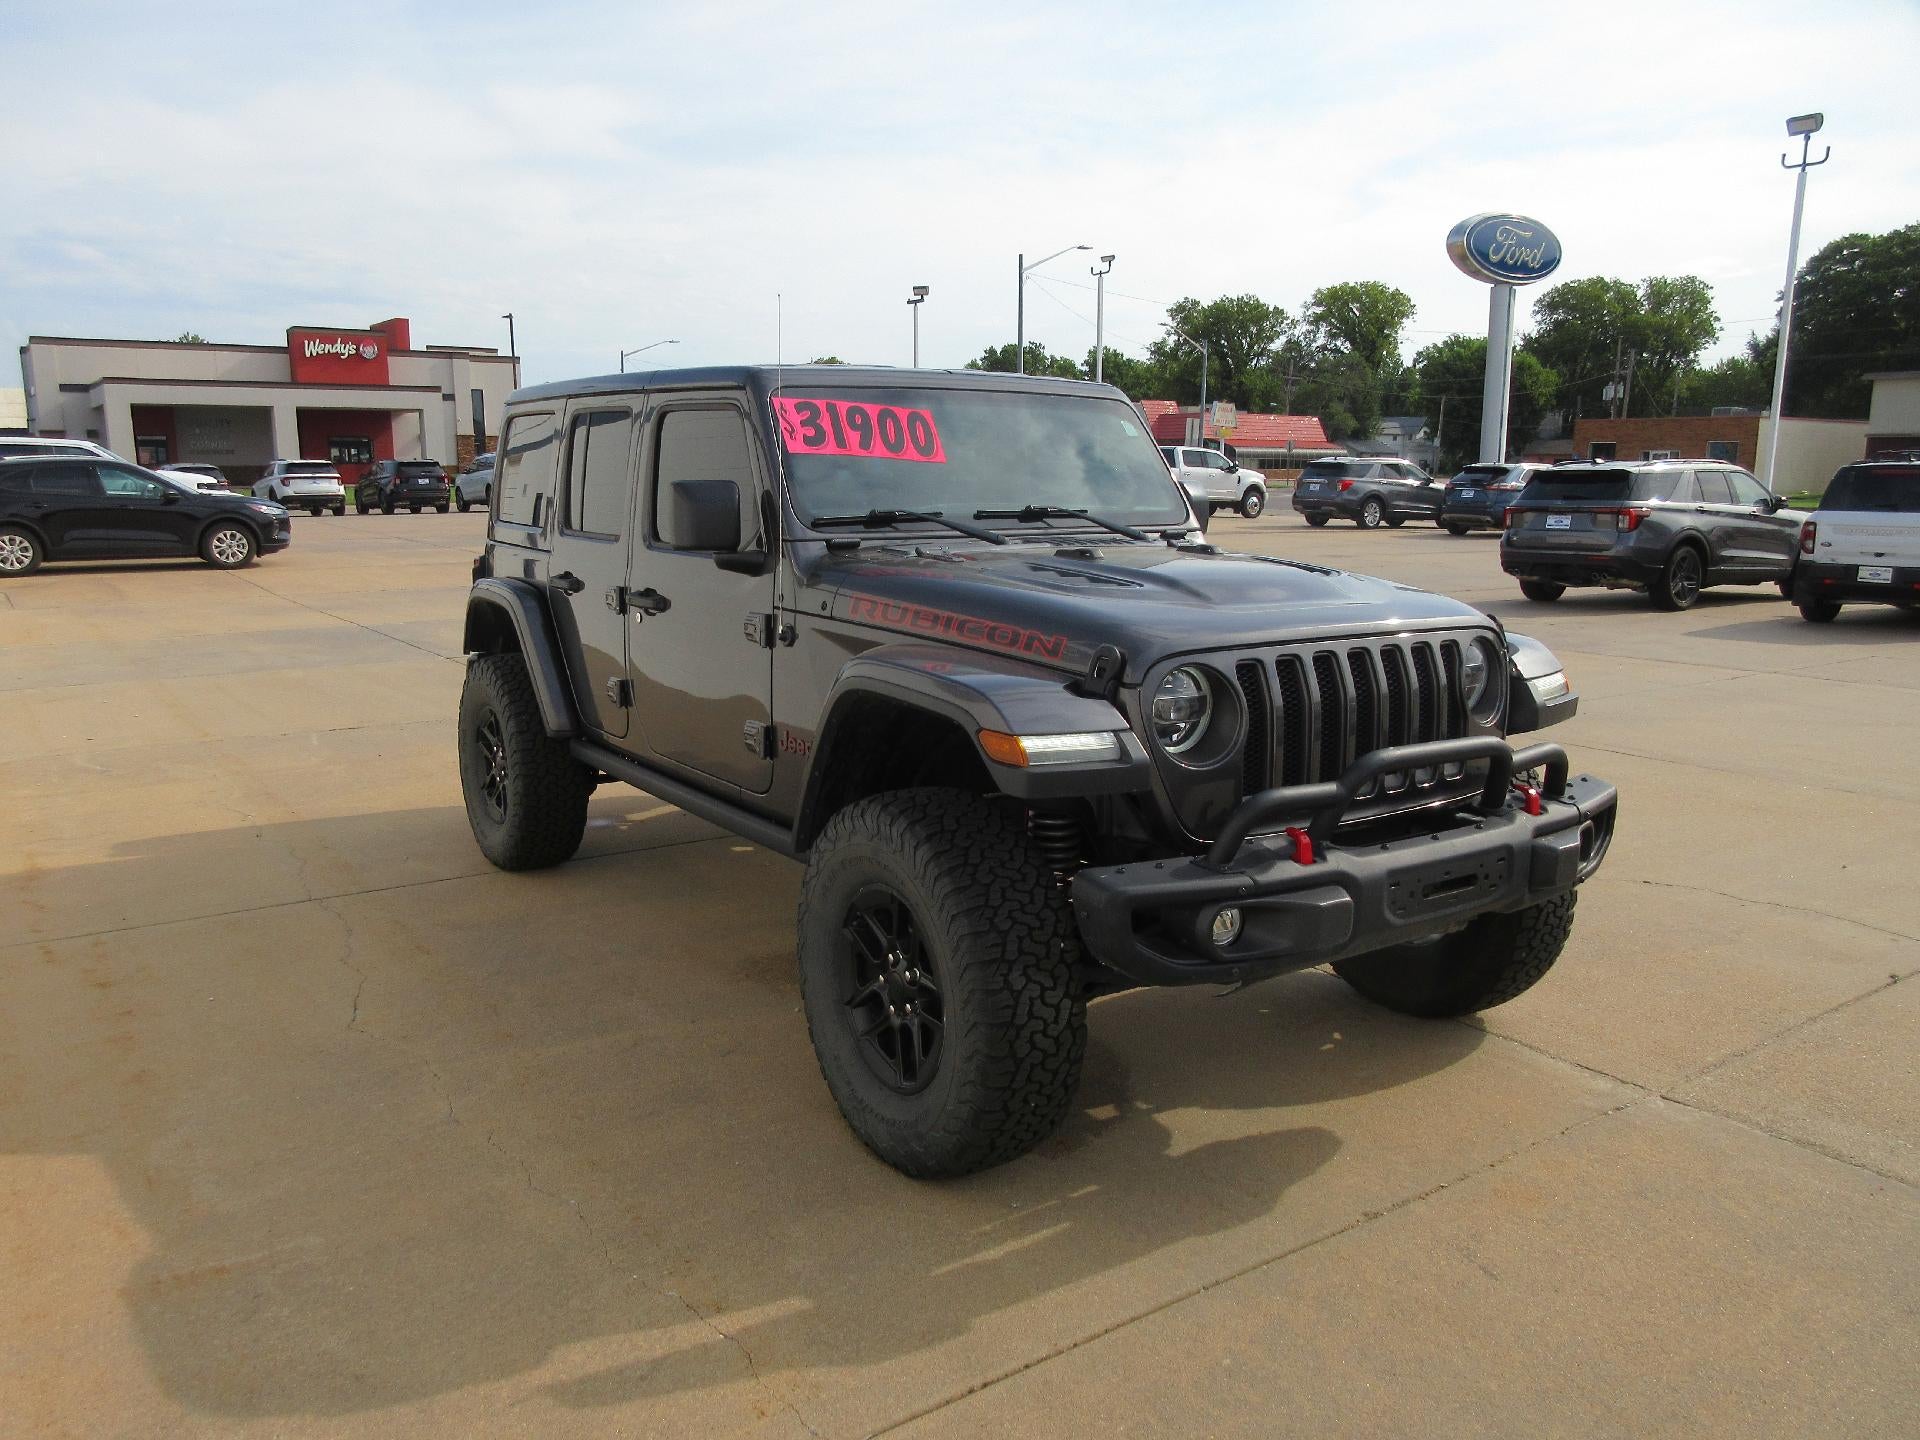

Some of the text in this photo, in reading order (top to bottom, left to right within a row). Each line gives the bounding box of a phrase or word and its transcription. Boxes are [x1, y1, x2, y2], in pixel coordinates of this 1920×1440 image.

[1489, 225, 1545, 269] Ford
[303, 337, 357, 359] Wendy's
[778, 400, 938, 458] $31900
[848, 591, 1069, 661] RUBICON
